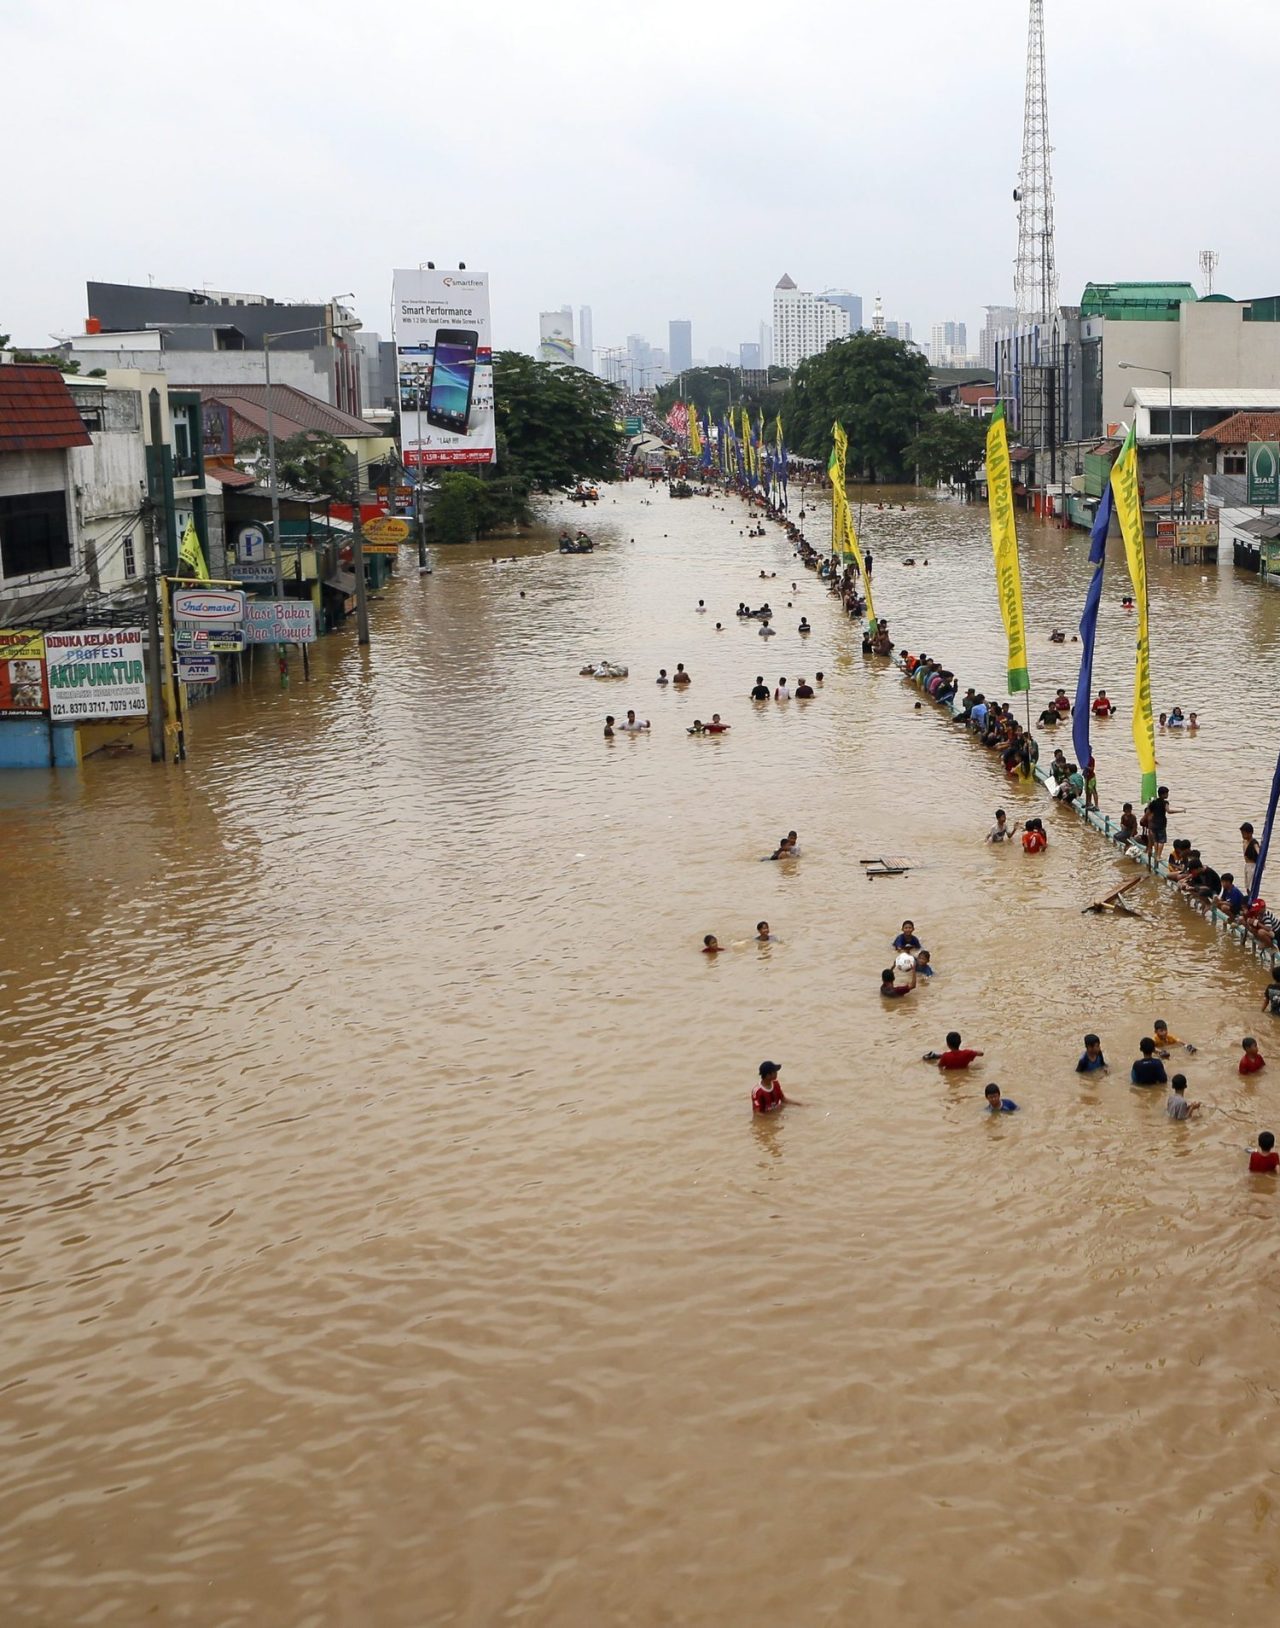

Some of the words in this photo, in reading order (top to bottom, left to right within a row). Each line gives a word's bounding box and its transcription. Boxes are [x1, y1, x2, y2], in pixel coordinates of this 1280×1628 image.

[402, 305, 424, 315] Smart
[426, 305, 472, 316] Performance
[180, 600, 237, 612] Indomaret
[246, 604, 271, 620] Nasi
[274, 604, 311, 619] Bakar
[272, 623, 312, 640] Penyet
[46, 634, 81, 648] DIBUKA
[84, 632, 114, 646] KELAS
[116, 631, 141, 644] BARU
[66, 647, 124, 660] PROFESI
[49, 660, 144, 689] AKUPUNKTUR
[70, 703, 87, 714] 8370
[110, 700, 127, 711] 7079
[128, 699, 146, 710] 1403
